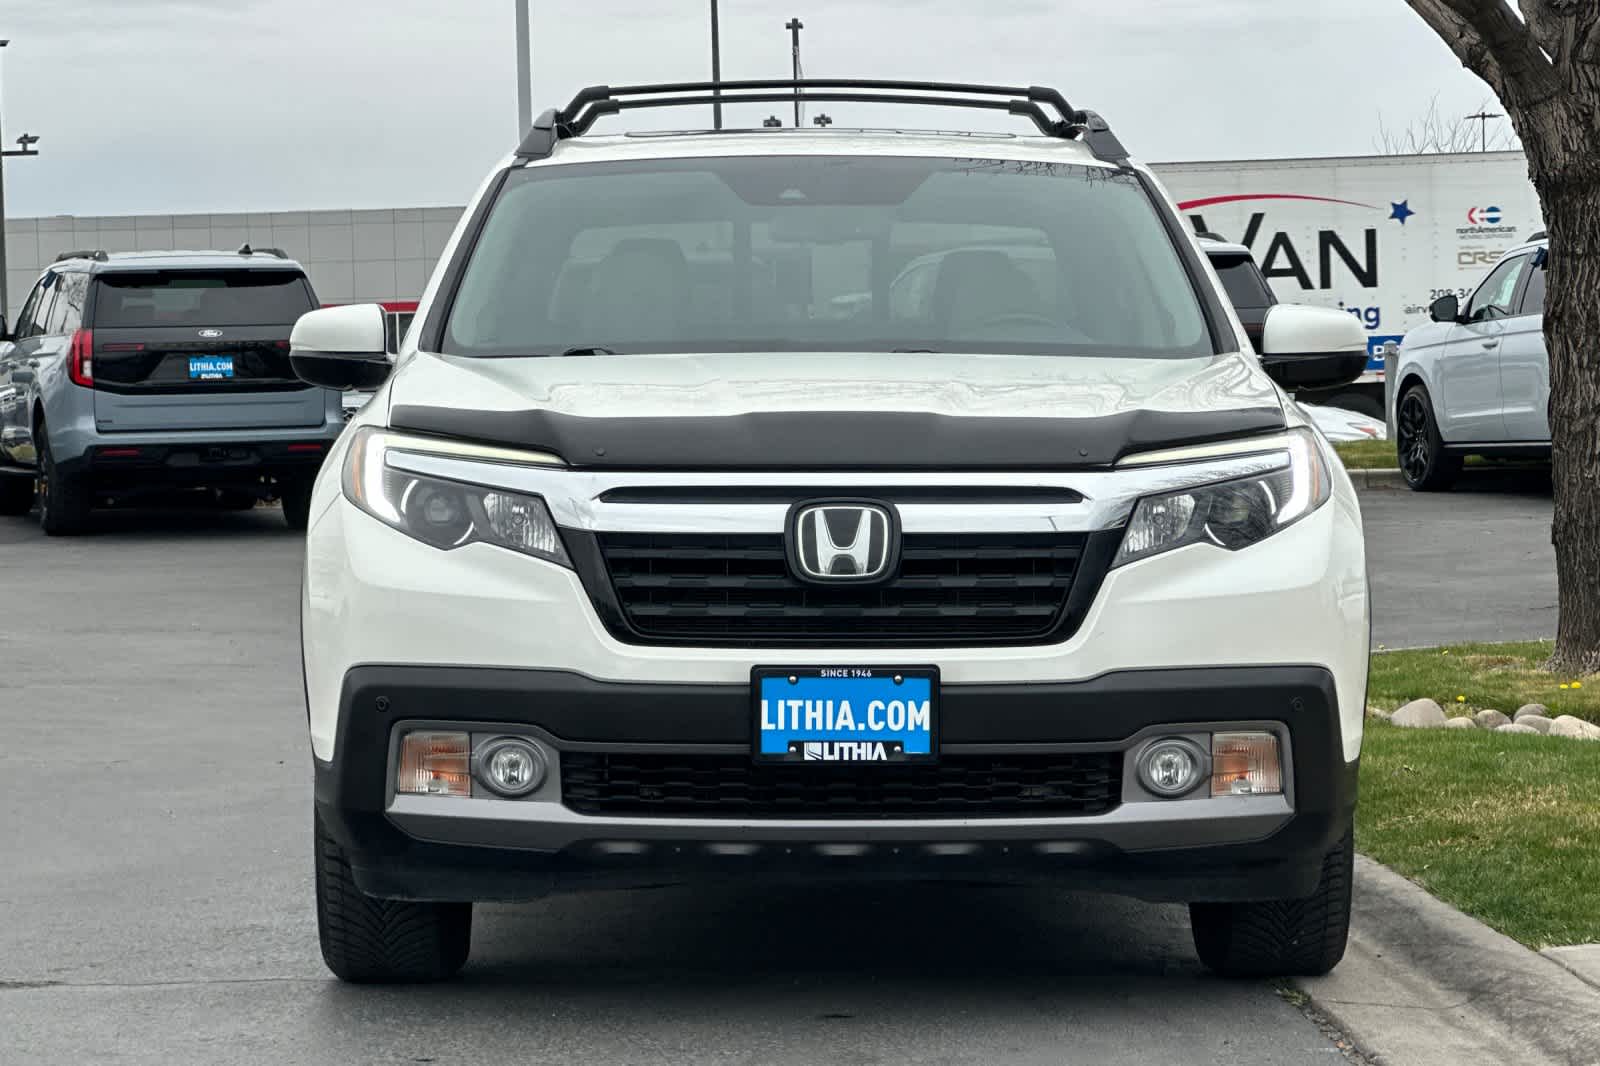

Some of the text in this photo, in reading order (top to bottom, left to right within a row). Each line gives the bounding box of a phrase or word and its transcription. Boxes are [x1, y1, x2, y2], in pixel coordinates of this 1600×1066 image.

[1458, 250, 1505, 265] CRS
[1430, 288, 1473, 300] 2083
[189, 362, 233, 371] LITHIA.COM
[820, 669, 872, 678] SINCE 1946
[760, 699, 931, 732] LITHIA.COM
[823, 742, 888, 761] LITHIA
